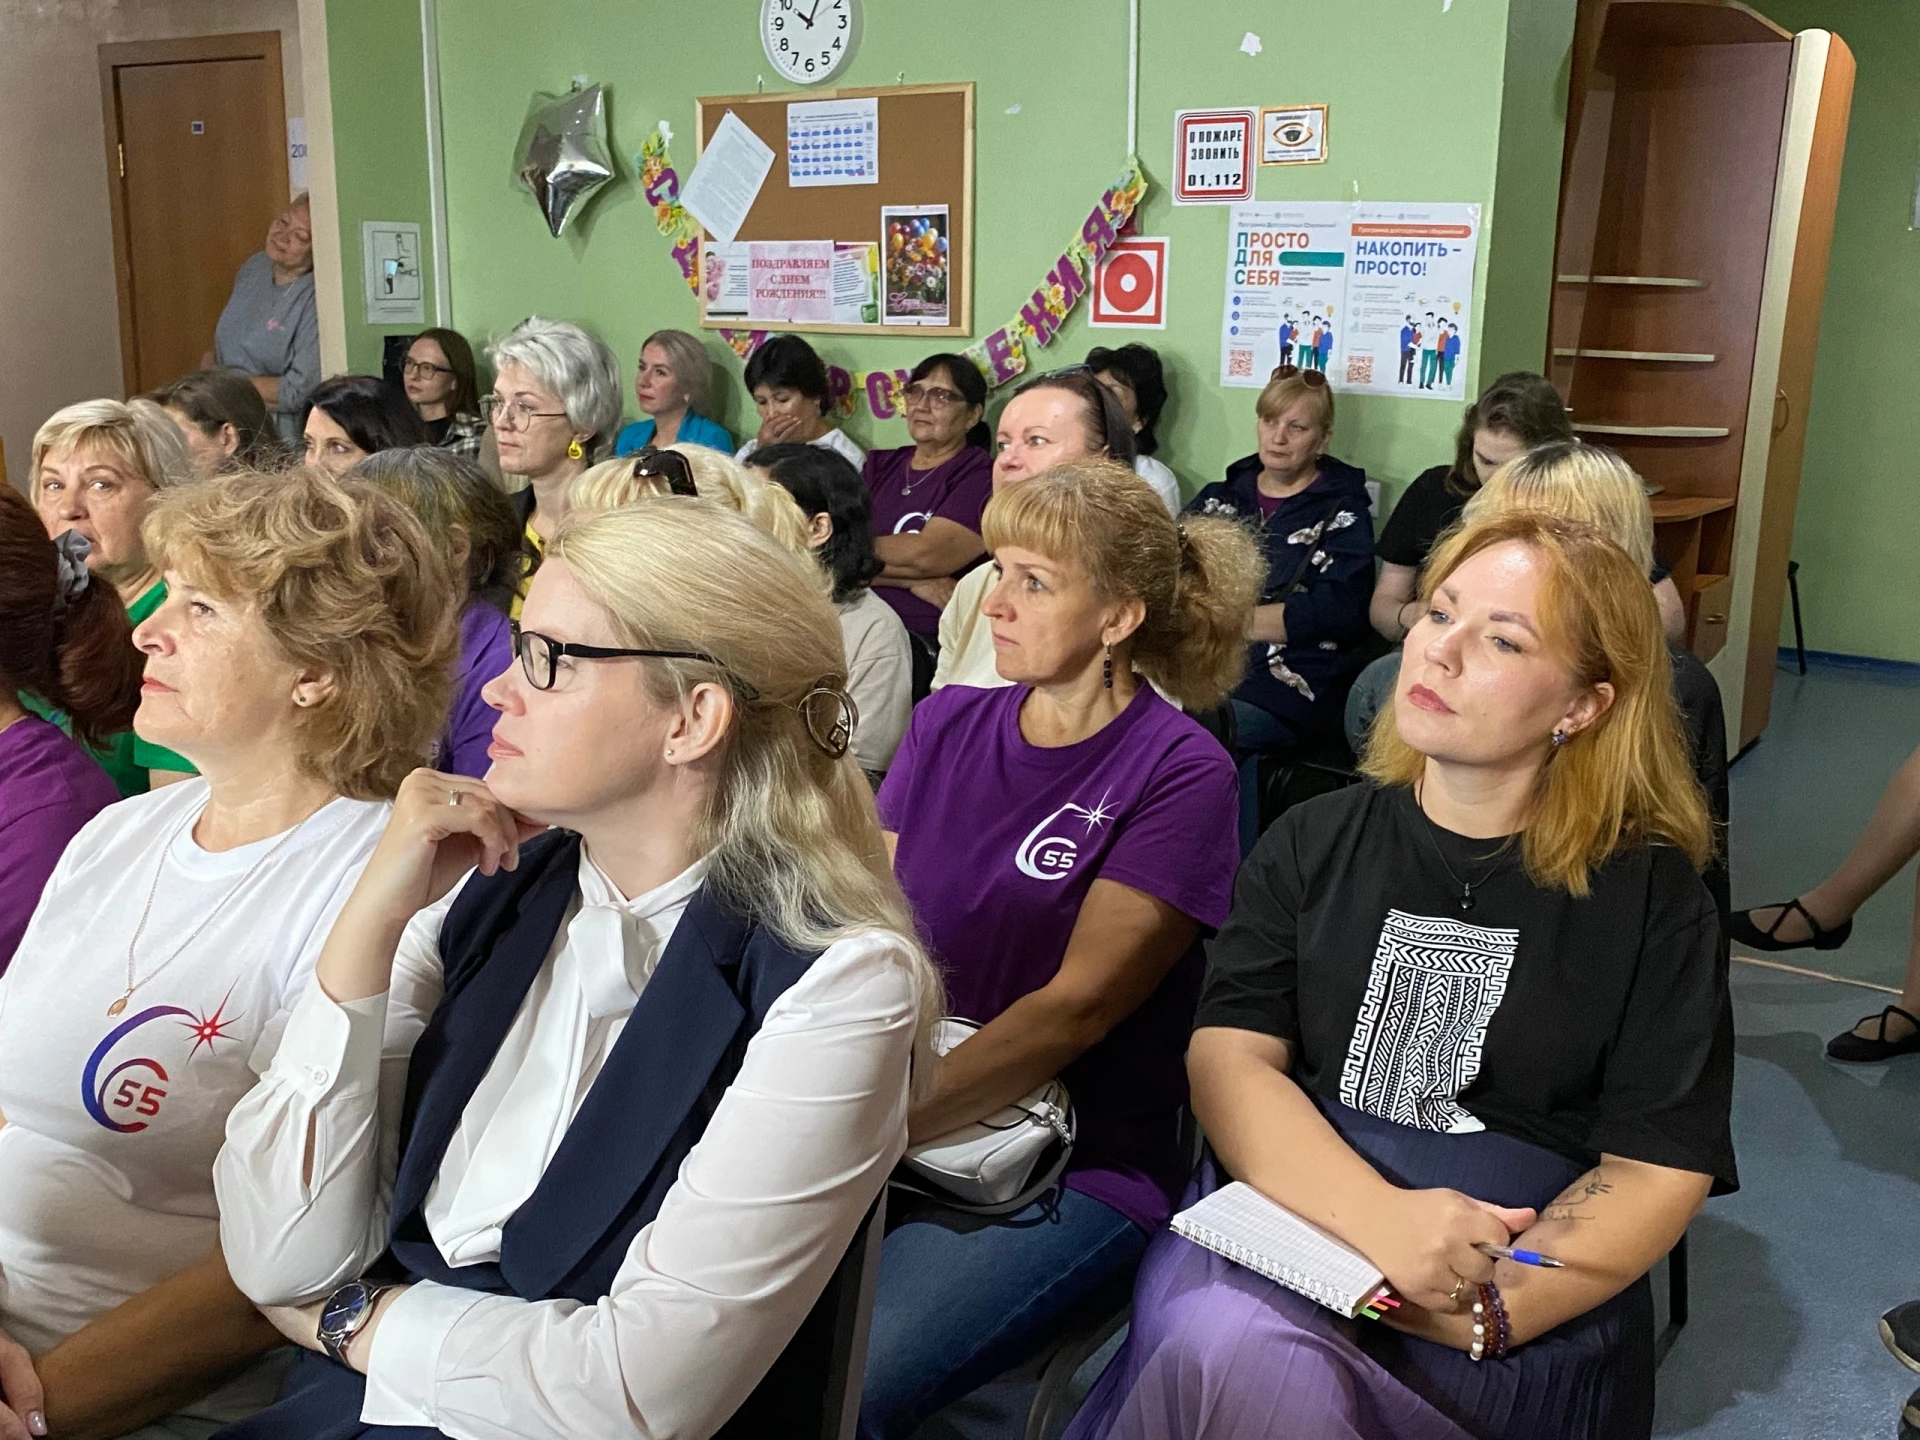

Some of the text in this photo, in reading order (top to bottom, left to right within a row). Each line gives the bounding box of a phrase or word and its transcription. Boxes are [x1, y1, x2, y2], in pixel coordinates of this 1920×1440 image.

[781, 0, 792, 10] 10
[774, 17, 784, 31] 9
[838, 15, 847, 29] 3
[780, 38, 789, 51] 8
[832, 36, 841, 50] 4
[791, 52, 799, 66] 7
[804, 58, 815, 72] 6
[821, 51, 830, 65] 5
[1189, 129, 1243, 143] О ПОЖАРЕ
[291, 144, 307, 158] 20
[1190, 147, 1240, 160] ЗВОНИТЬ
[1237, 232, 1310, 249] ПРОСТО
[1356, 241, 1448, 257] НАКОПИТЬ
[751, 259, 830, 269] ПОЗДРАВЛЯЕМ
[1234, 249, 1273, 267] ДЛЯ
[1355, 260, 1427, 276] ПРОСТО!
[770, 274, 810, 285] С ДНЕМ
[1234, 269, 1280, 286] СЕБЯ
[755, 289, 826, 299] РОЖДЕНИЯ!!!
[1041, 849, 1077, 869] 55
[113, 1079, 167, 1116] 55
